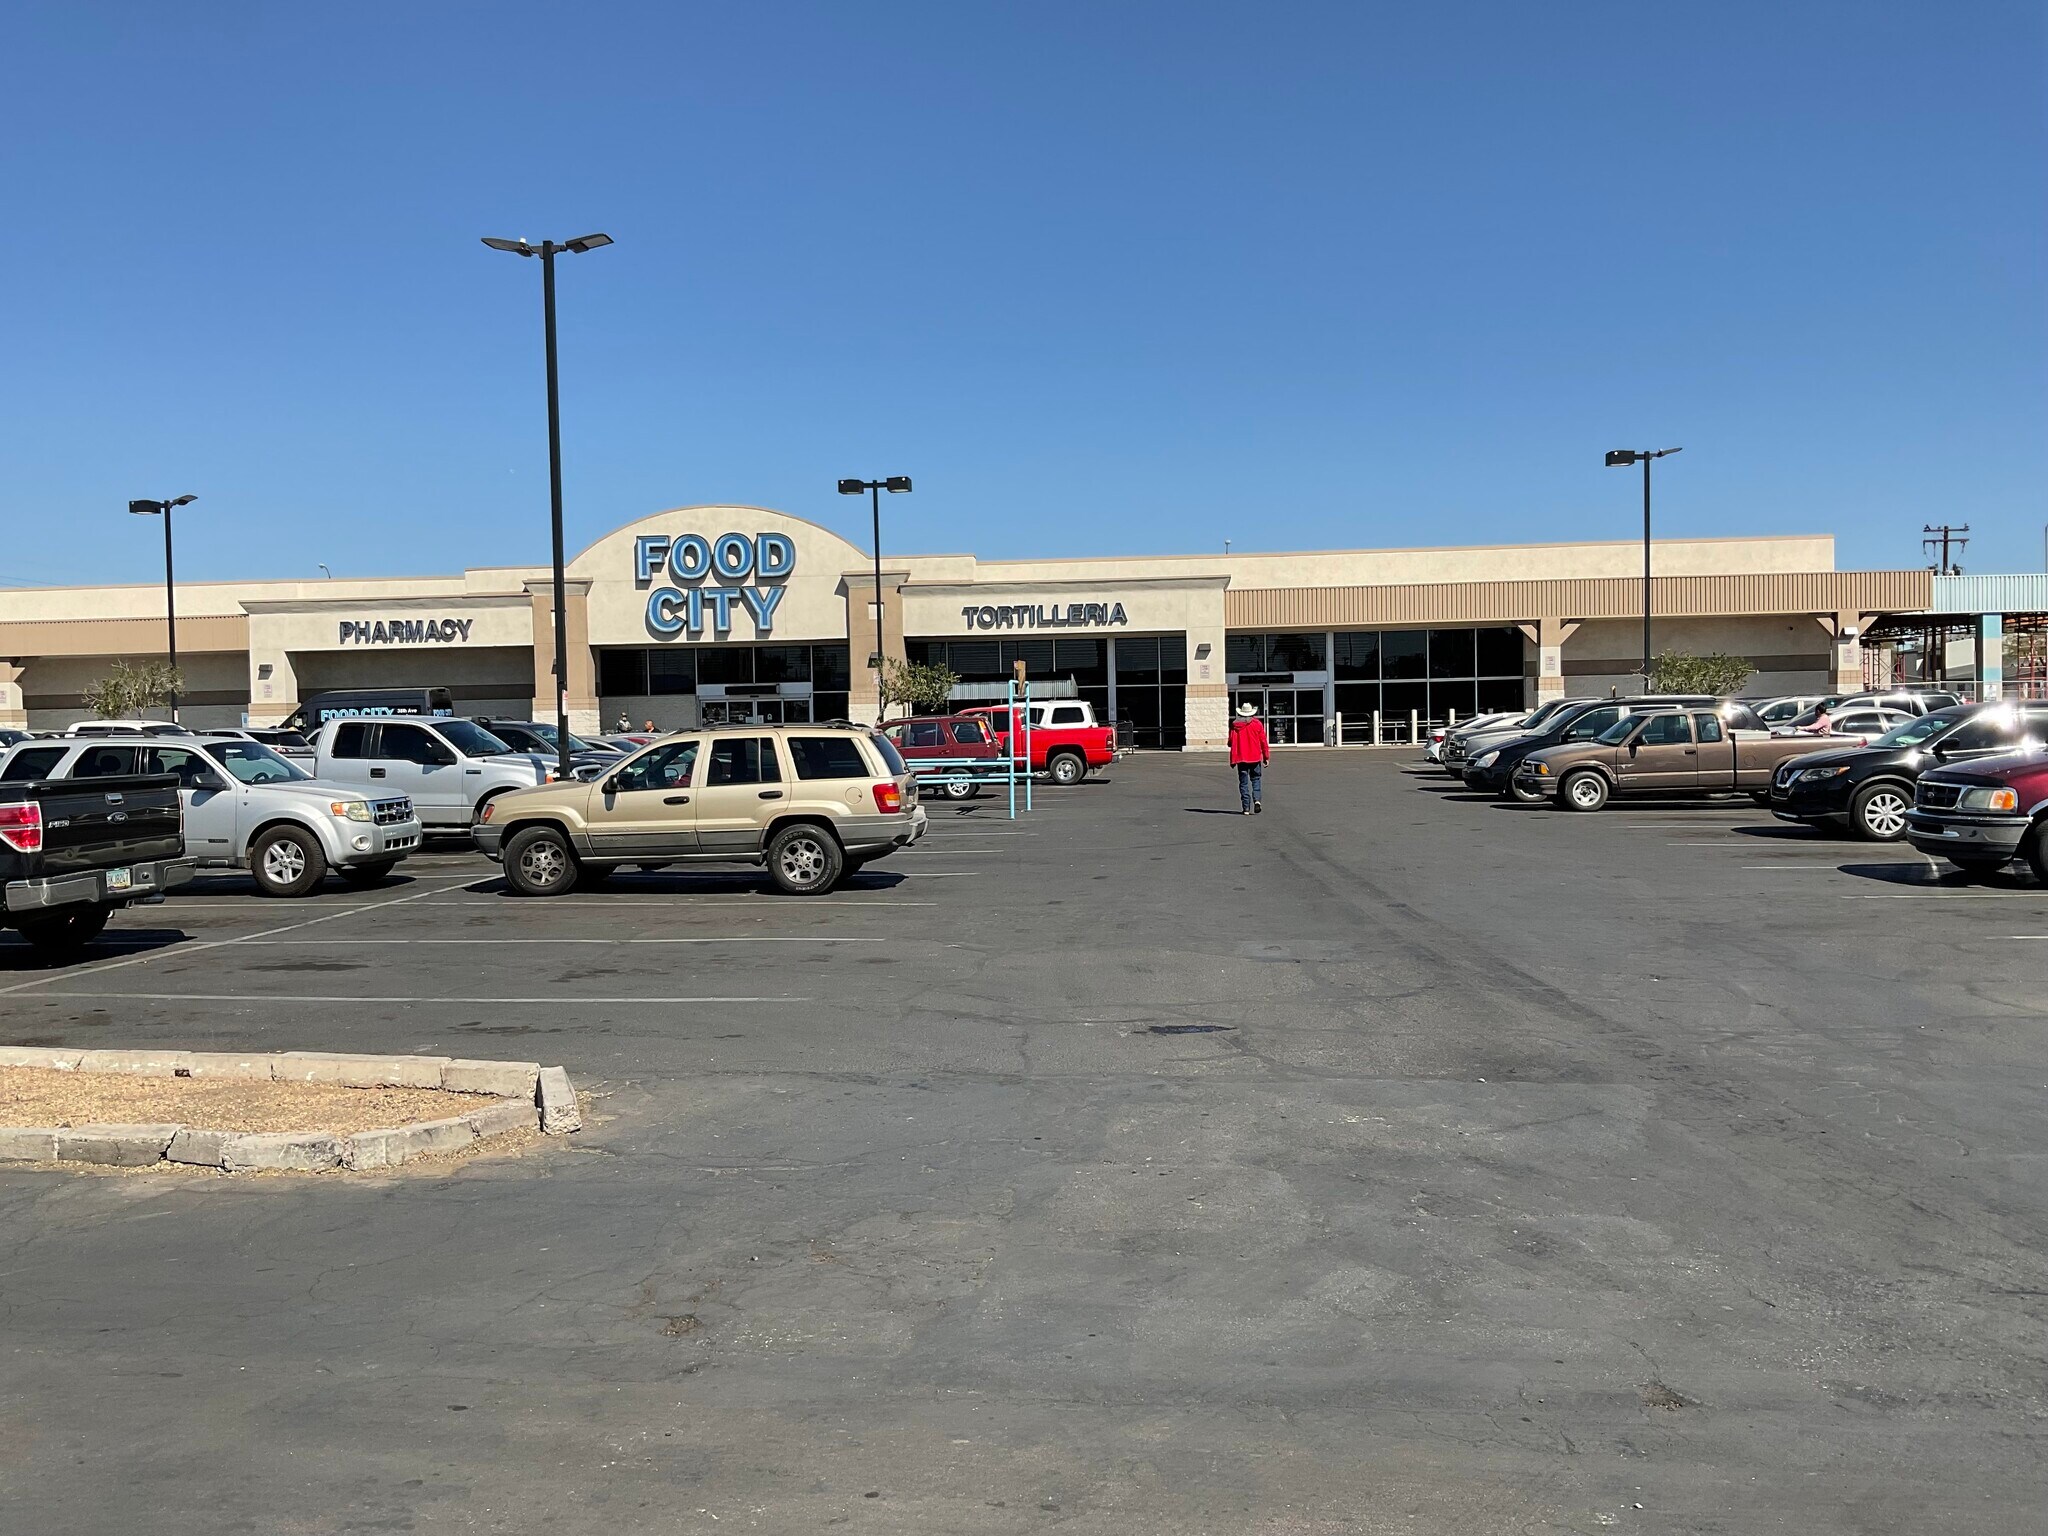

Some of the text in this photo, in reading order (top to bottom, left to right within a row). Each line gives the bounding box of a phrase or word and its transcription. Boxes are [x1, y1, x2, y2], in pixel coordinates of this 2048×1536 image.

[635, 532, 796, 584] FOOD
[646, 585, 787, 637] CITY
[962, 602, 1128, 630] TORTILLERIA
[339, 619, 473, 644] PHARMACY
[320, 707, 395, 722] FOOD CITY
